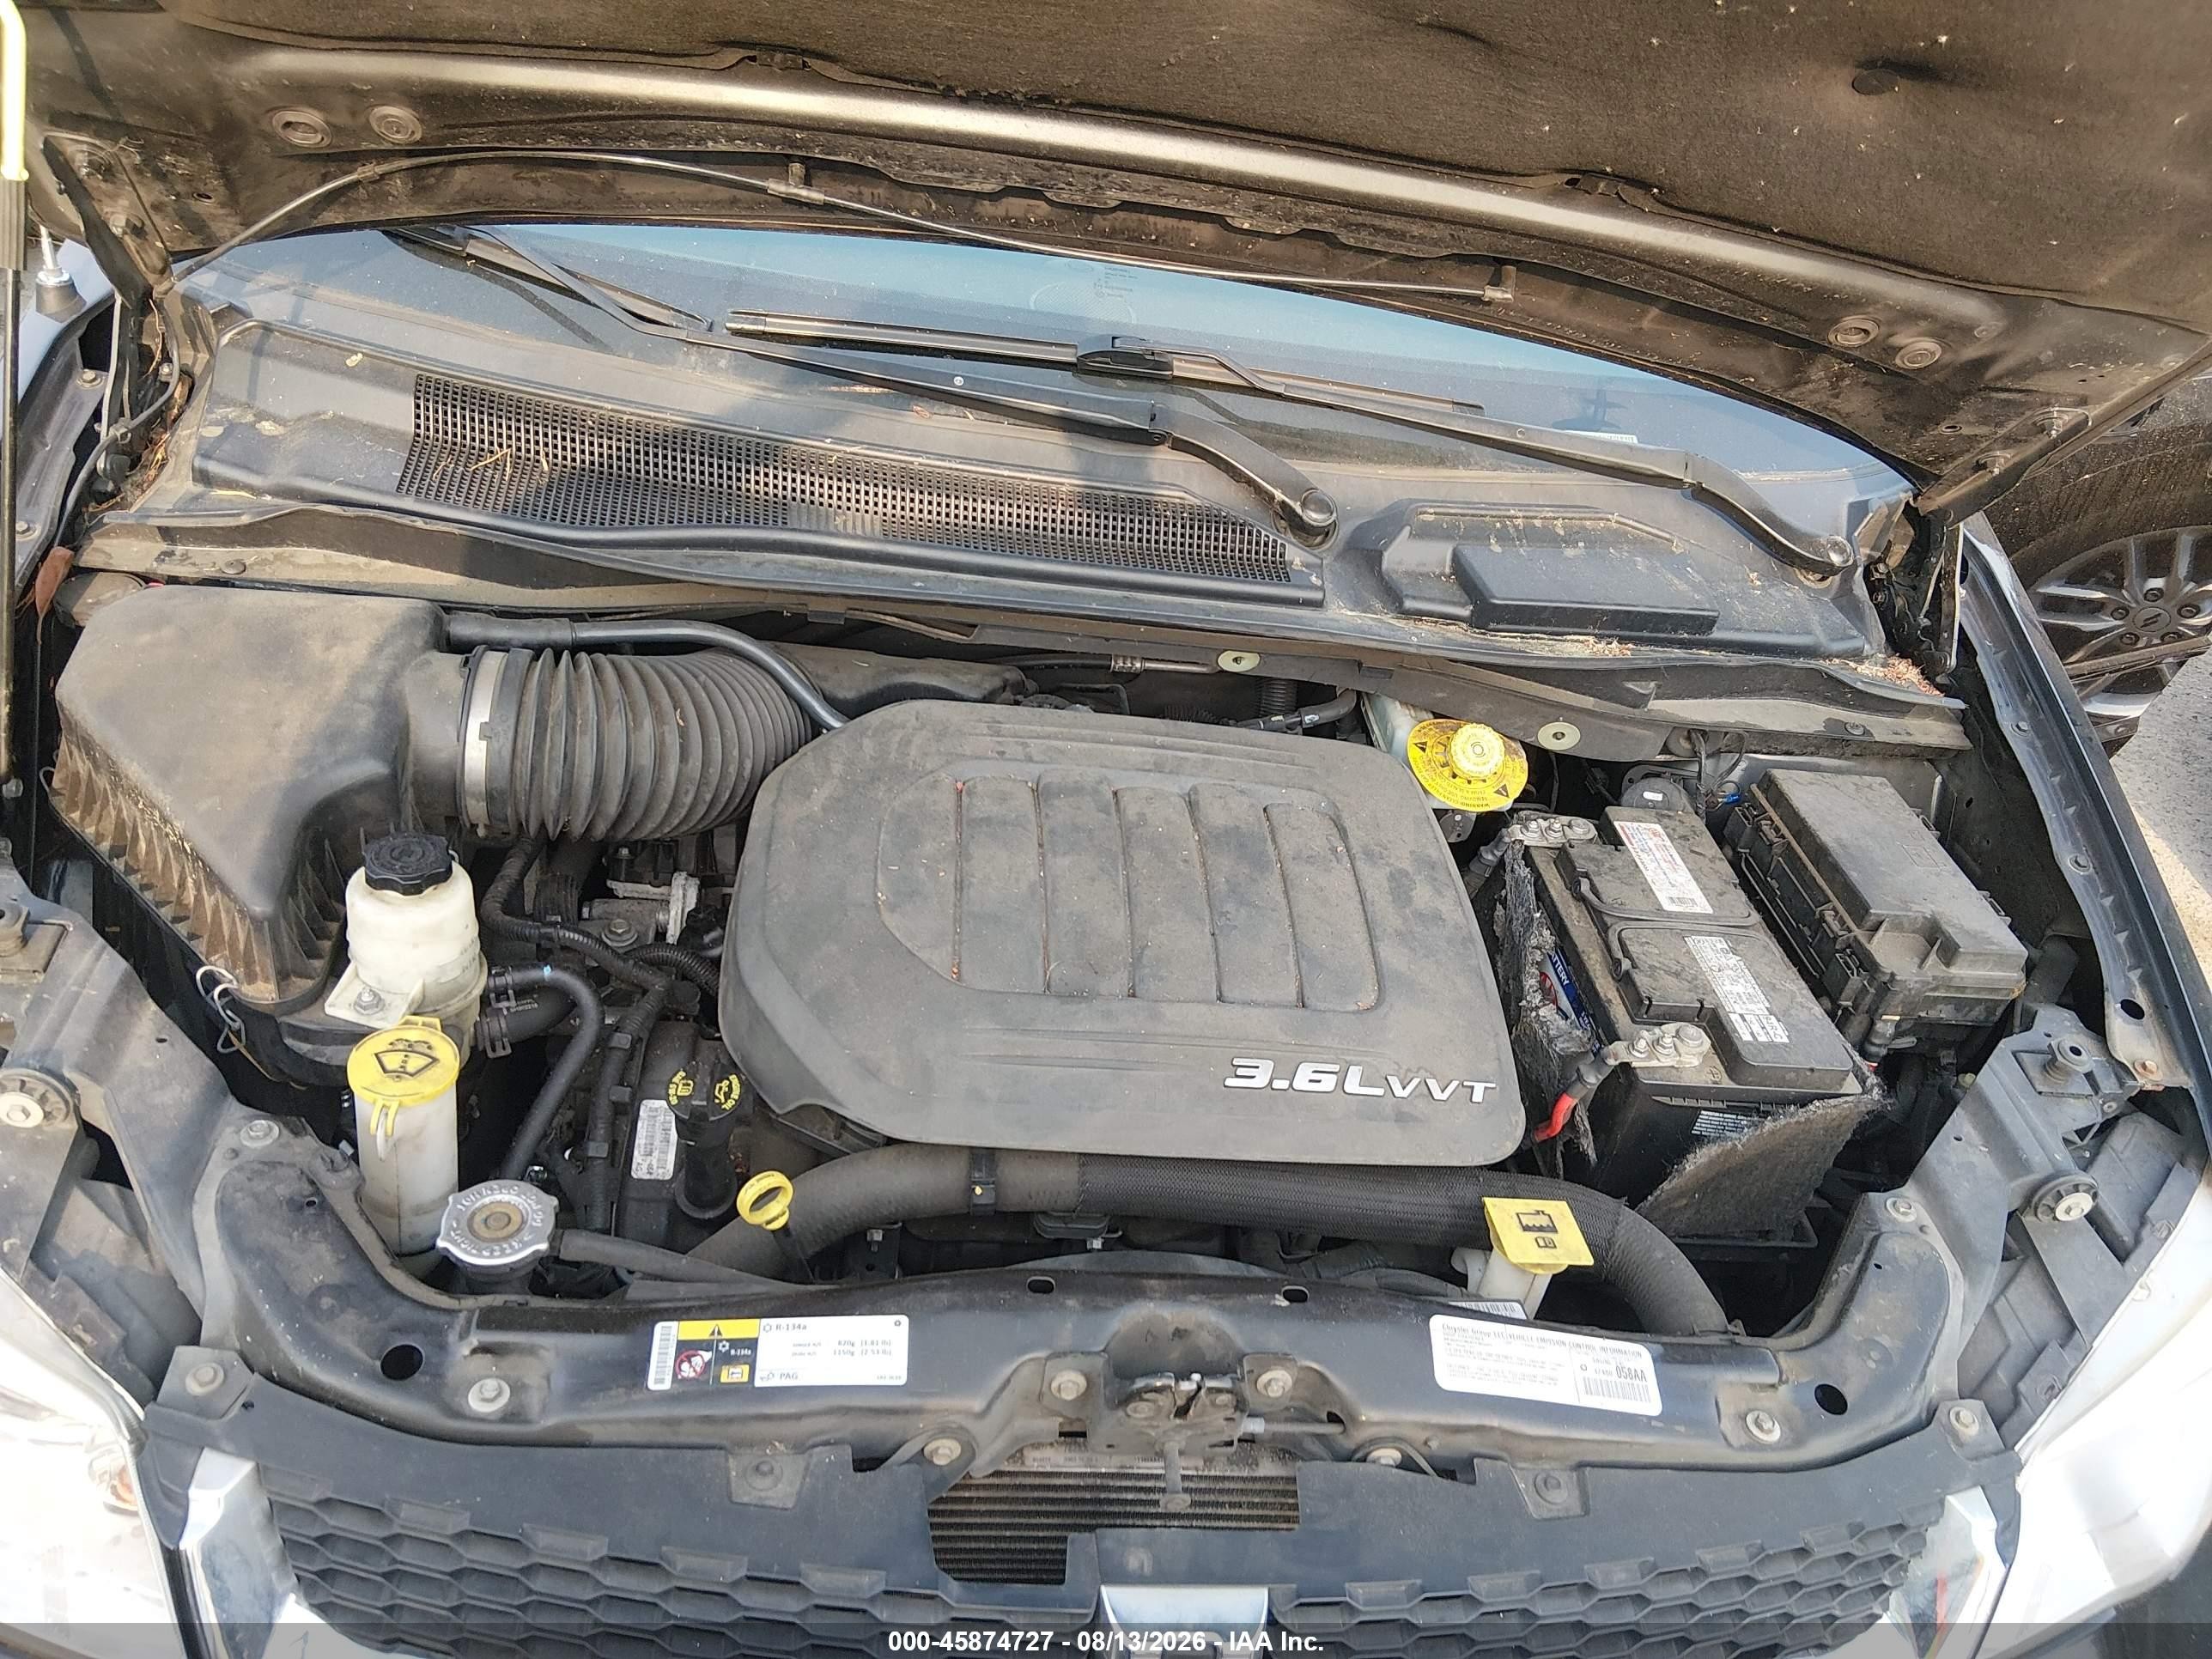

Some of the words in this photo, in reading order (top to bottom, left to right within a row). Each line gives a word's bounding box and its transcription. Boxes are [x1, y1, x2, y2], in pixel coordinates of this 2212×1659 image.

[1551, 948, 1571, 987] ATTERY
[721, 1098, 737, 1111] OIL
[1599, 1346, 1642, 1358] INFORMATION
[780, 1372, 799, 1381] PAG
[1615, 1365, 1648, 1382] 058AA
